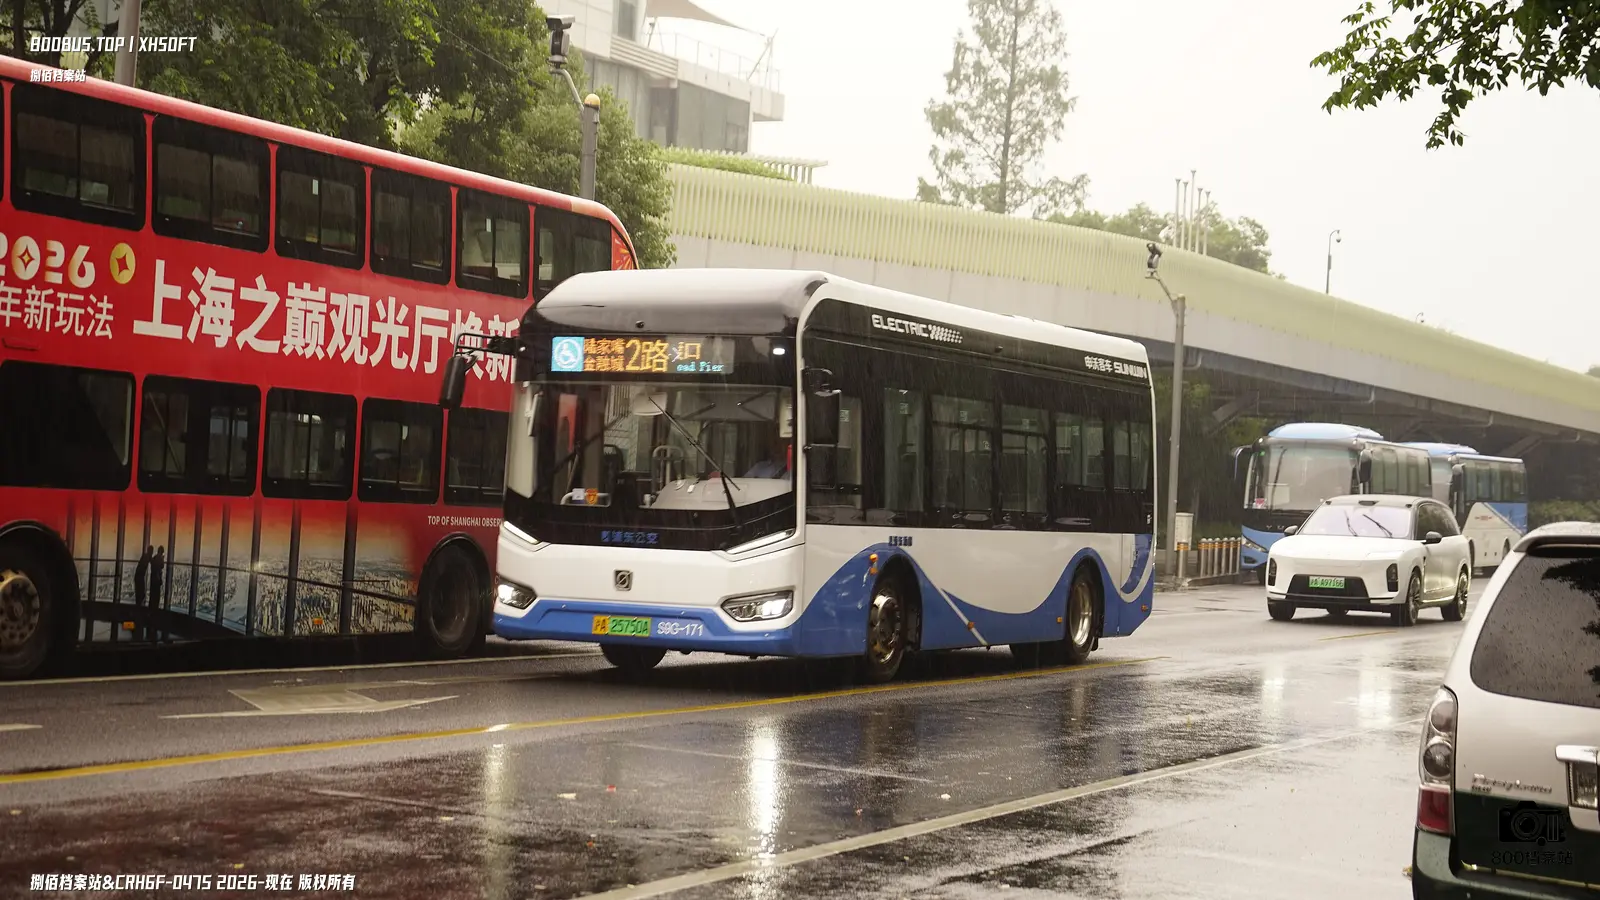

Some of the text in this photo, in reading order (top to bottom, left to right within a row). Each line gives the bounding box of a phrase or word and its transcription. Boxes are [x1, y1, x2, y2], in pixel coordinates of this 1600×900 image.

[0, 280, 114, 340] 年新玩法
[871, 313, 929, 338] ELECTRIC
[625, 338, 670, 373] 2路
[699, 361, 724, 372] Pier
[1113, 361, 1148, 379] SUNWIN
[428, 515, 440, 525] TOP
[441, 516, 450, 526] OF
[450, 516, 481, 527] SHANGHAI
